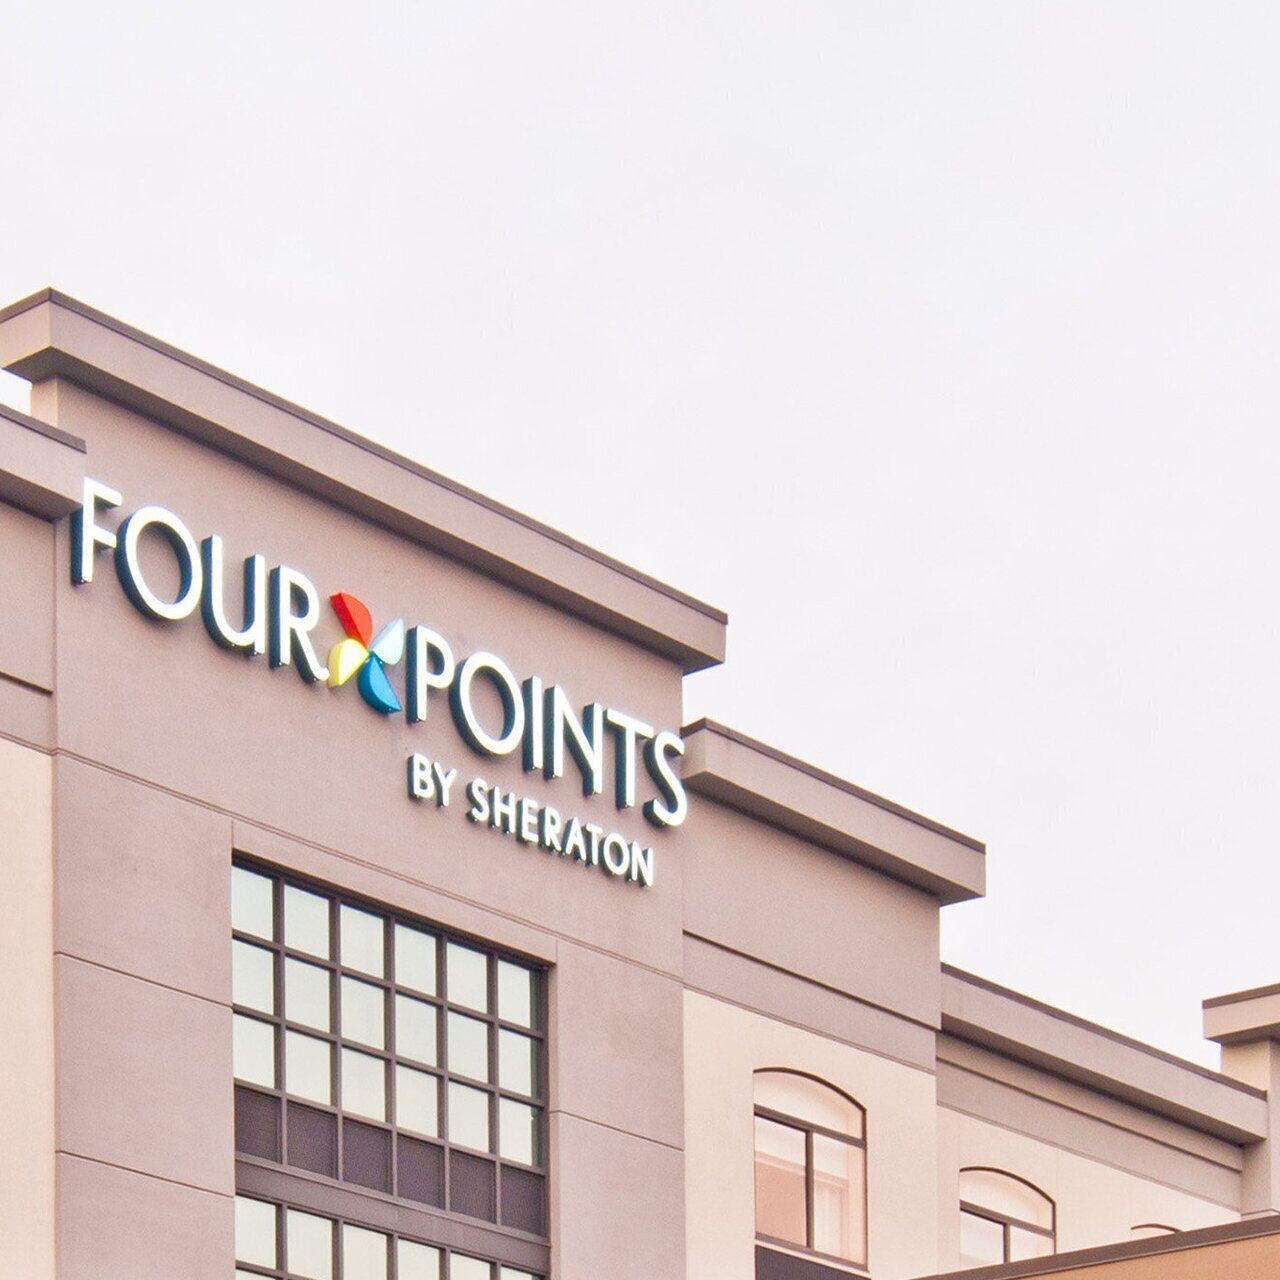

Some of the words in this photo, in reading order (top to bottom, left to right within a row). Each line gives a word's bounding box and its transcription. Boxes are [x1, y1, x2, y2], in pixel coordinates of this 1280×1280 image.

[71, 475, 331, 683] FOUR
[406, 624, 688, 827] POINTS
[408, 752, 457, 808] BY
[466, 777, 654, 887] SHERATON
